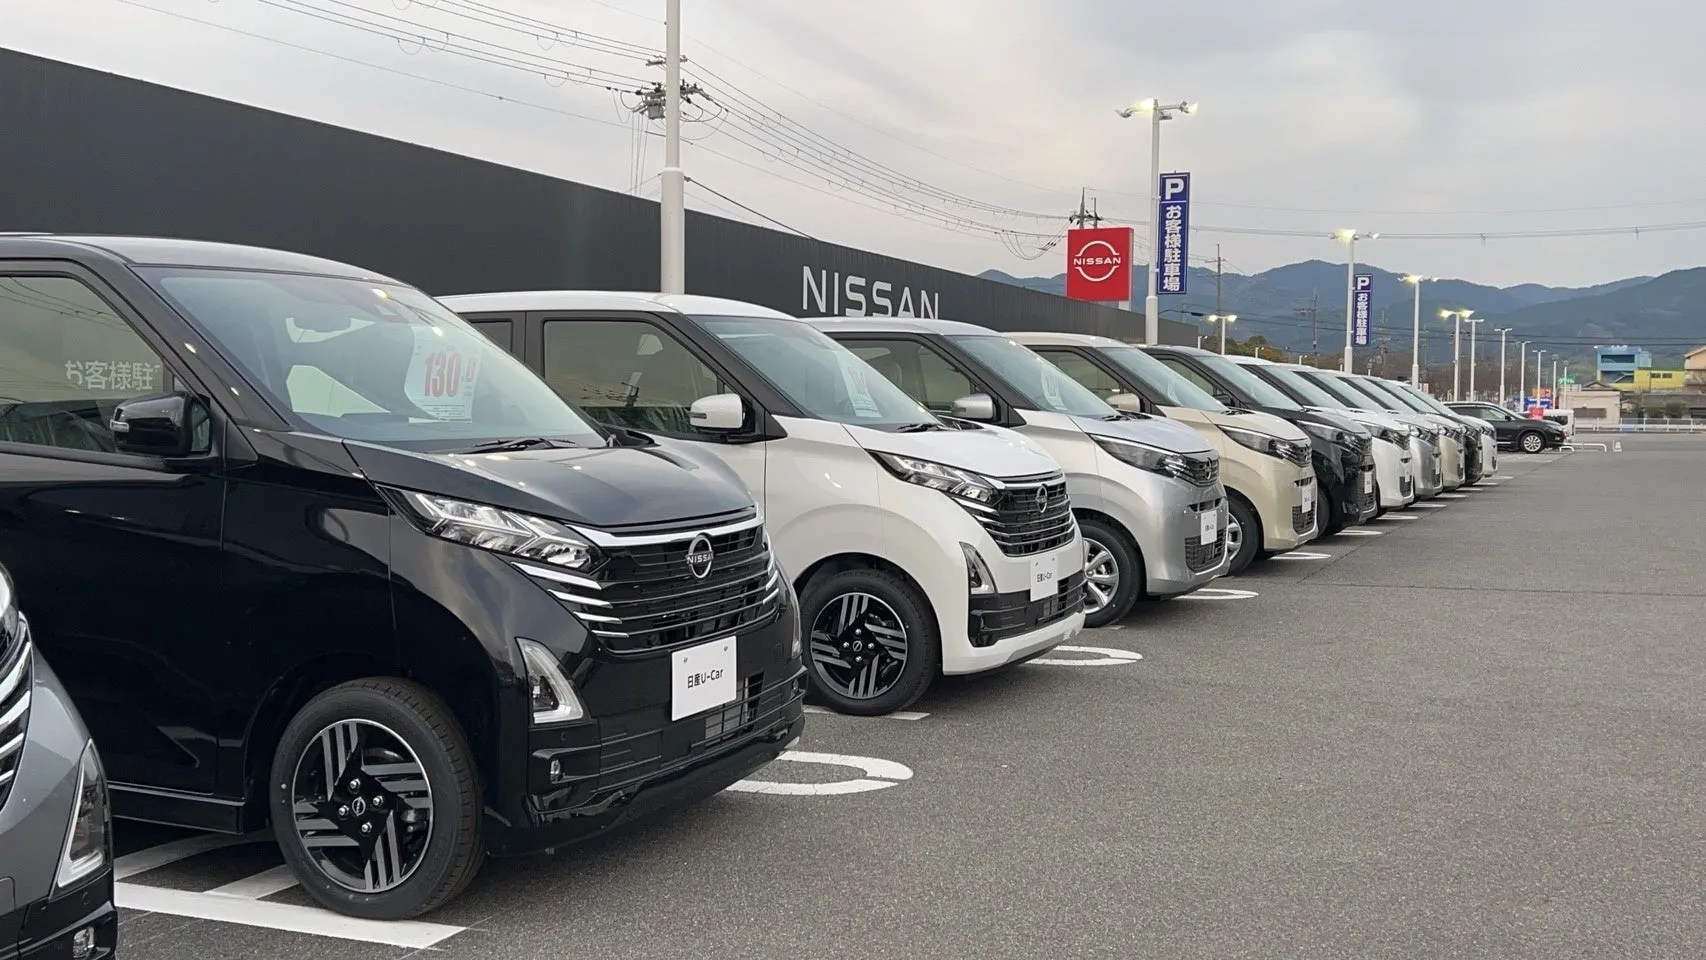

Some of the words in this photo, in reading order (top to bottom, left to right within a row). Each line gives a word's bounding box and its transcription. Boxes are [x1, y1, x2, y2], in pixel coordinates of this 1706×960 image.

[1165, 178, 1185, 200] P
[1163, 205, 1182, 291] お客様駐車場
[1073, 257, 1121, 266] NISSAN
[803, 265, 939, 320] NISSAN
[1357, 277, 1370, 290] P
[65, 360, 160, 390] お客様駐
[687, 669, 723, 688] 日産U-Car
